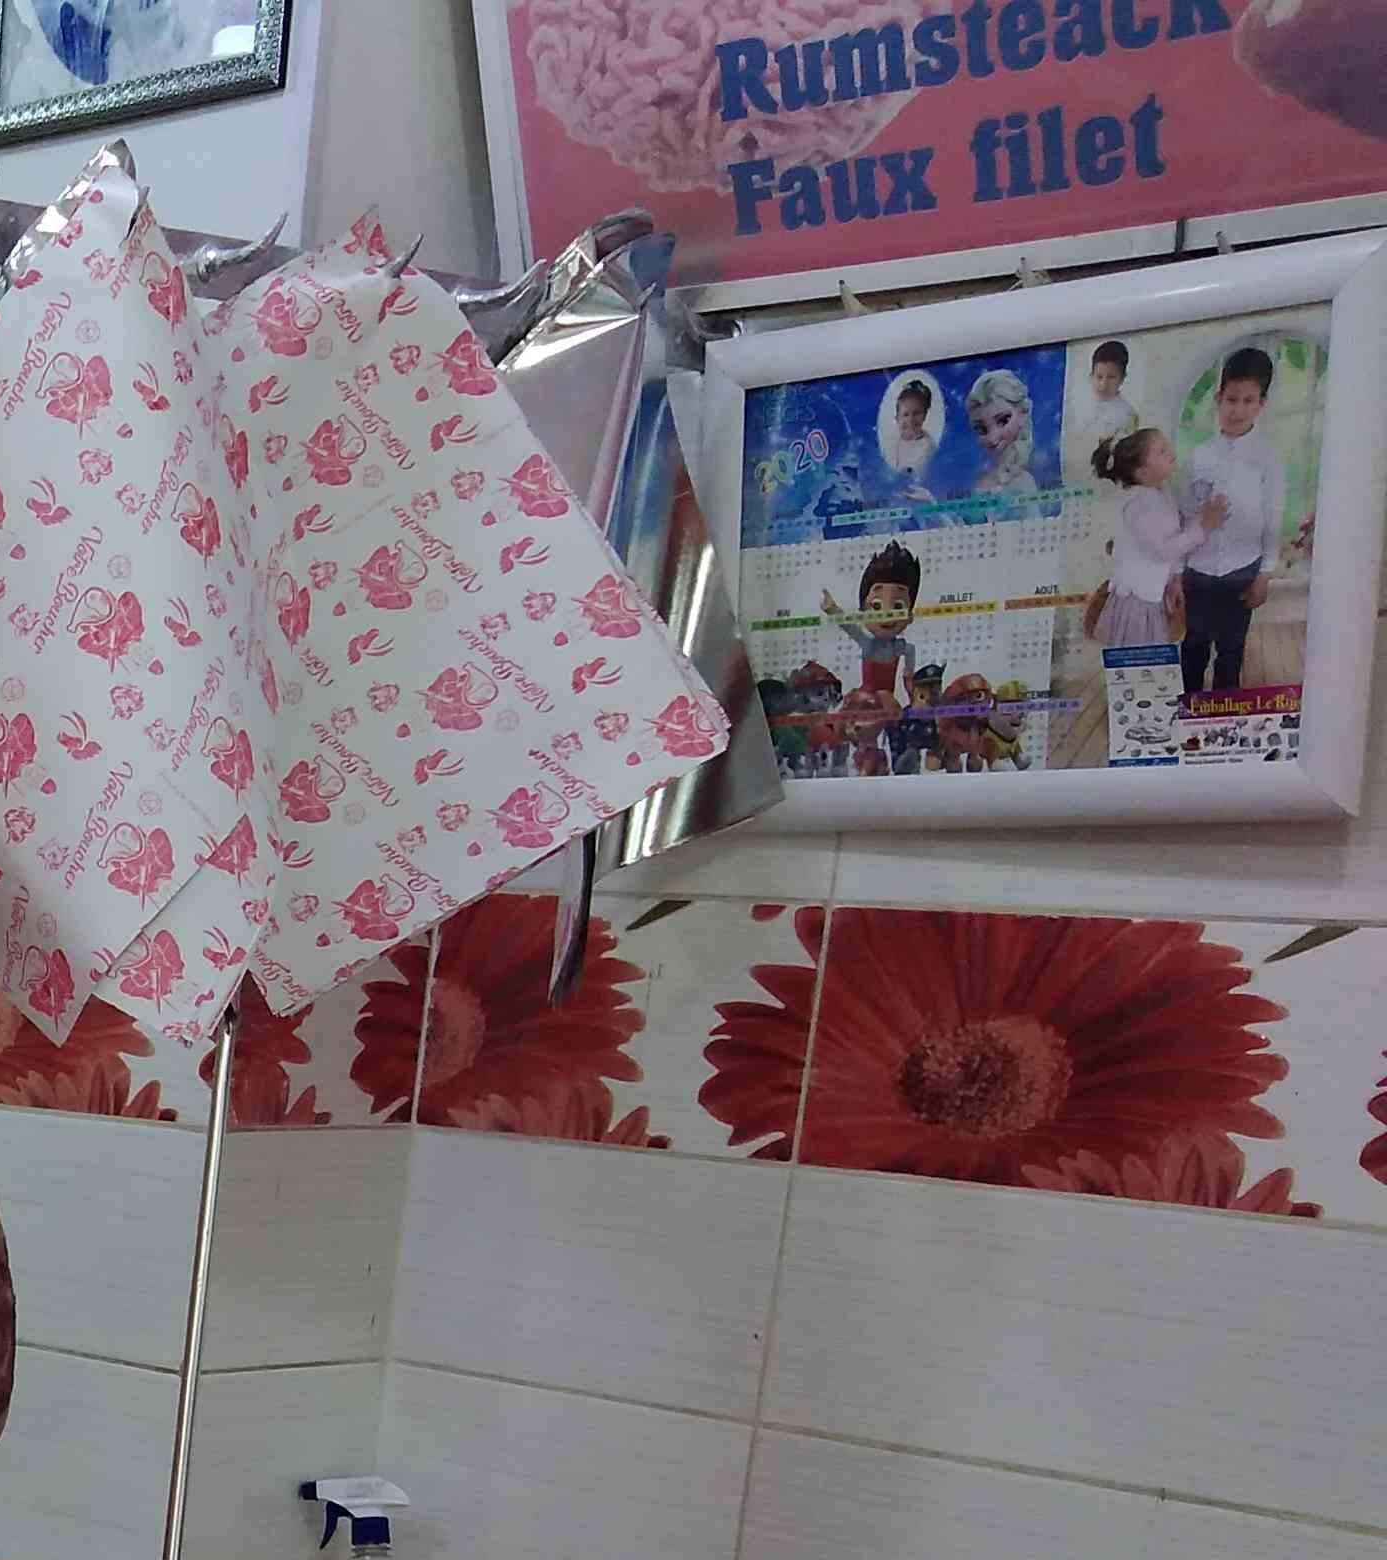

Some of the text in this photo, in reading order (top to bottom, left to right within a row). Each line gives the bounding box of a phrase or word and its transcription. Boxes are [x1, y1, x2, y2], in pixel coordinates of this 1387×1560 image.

[728, 92, 1166, 237] Faux filet
[2, 339, 48, 421] Boucher
[33, 526, 104, 656] Votre Boucher
[63, 760, 134, 891] Votre Boucher
